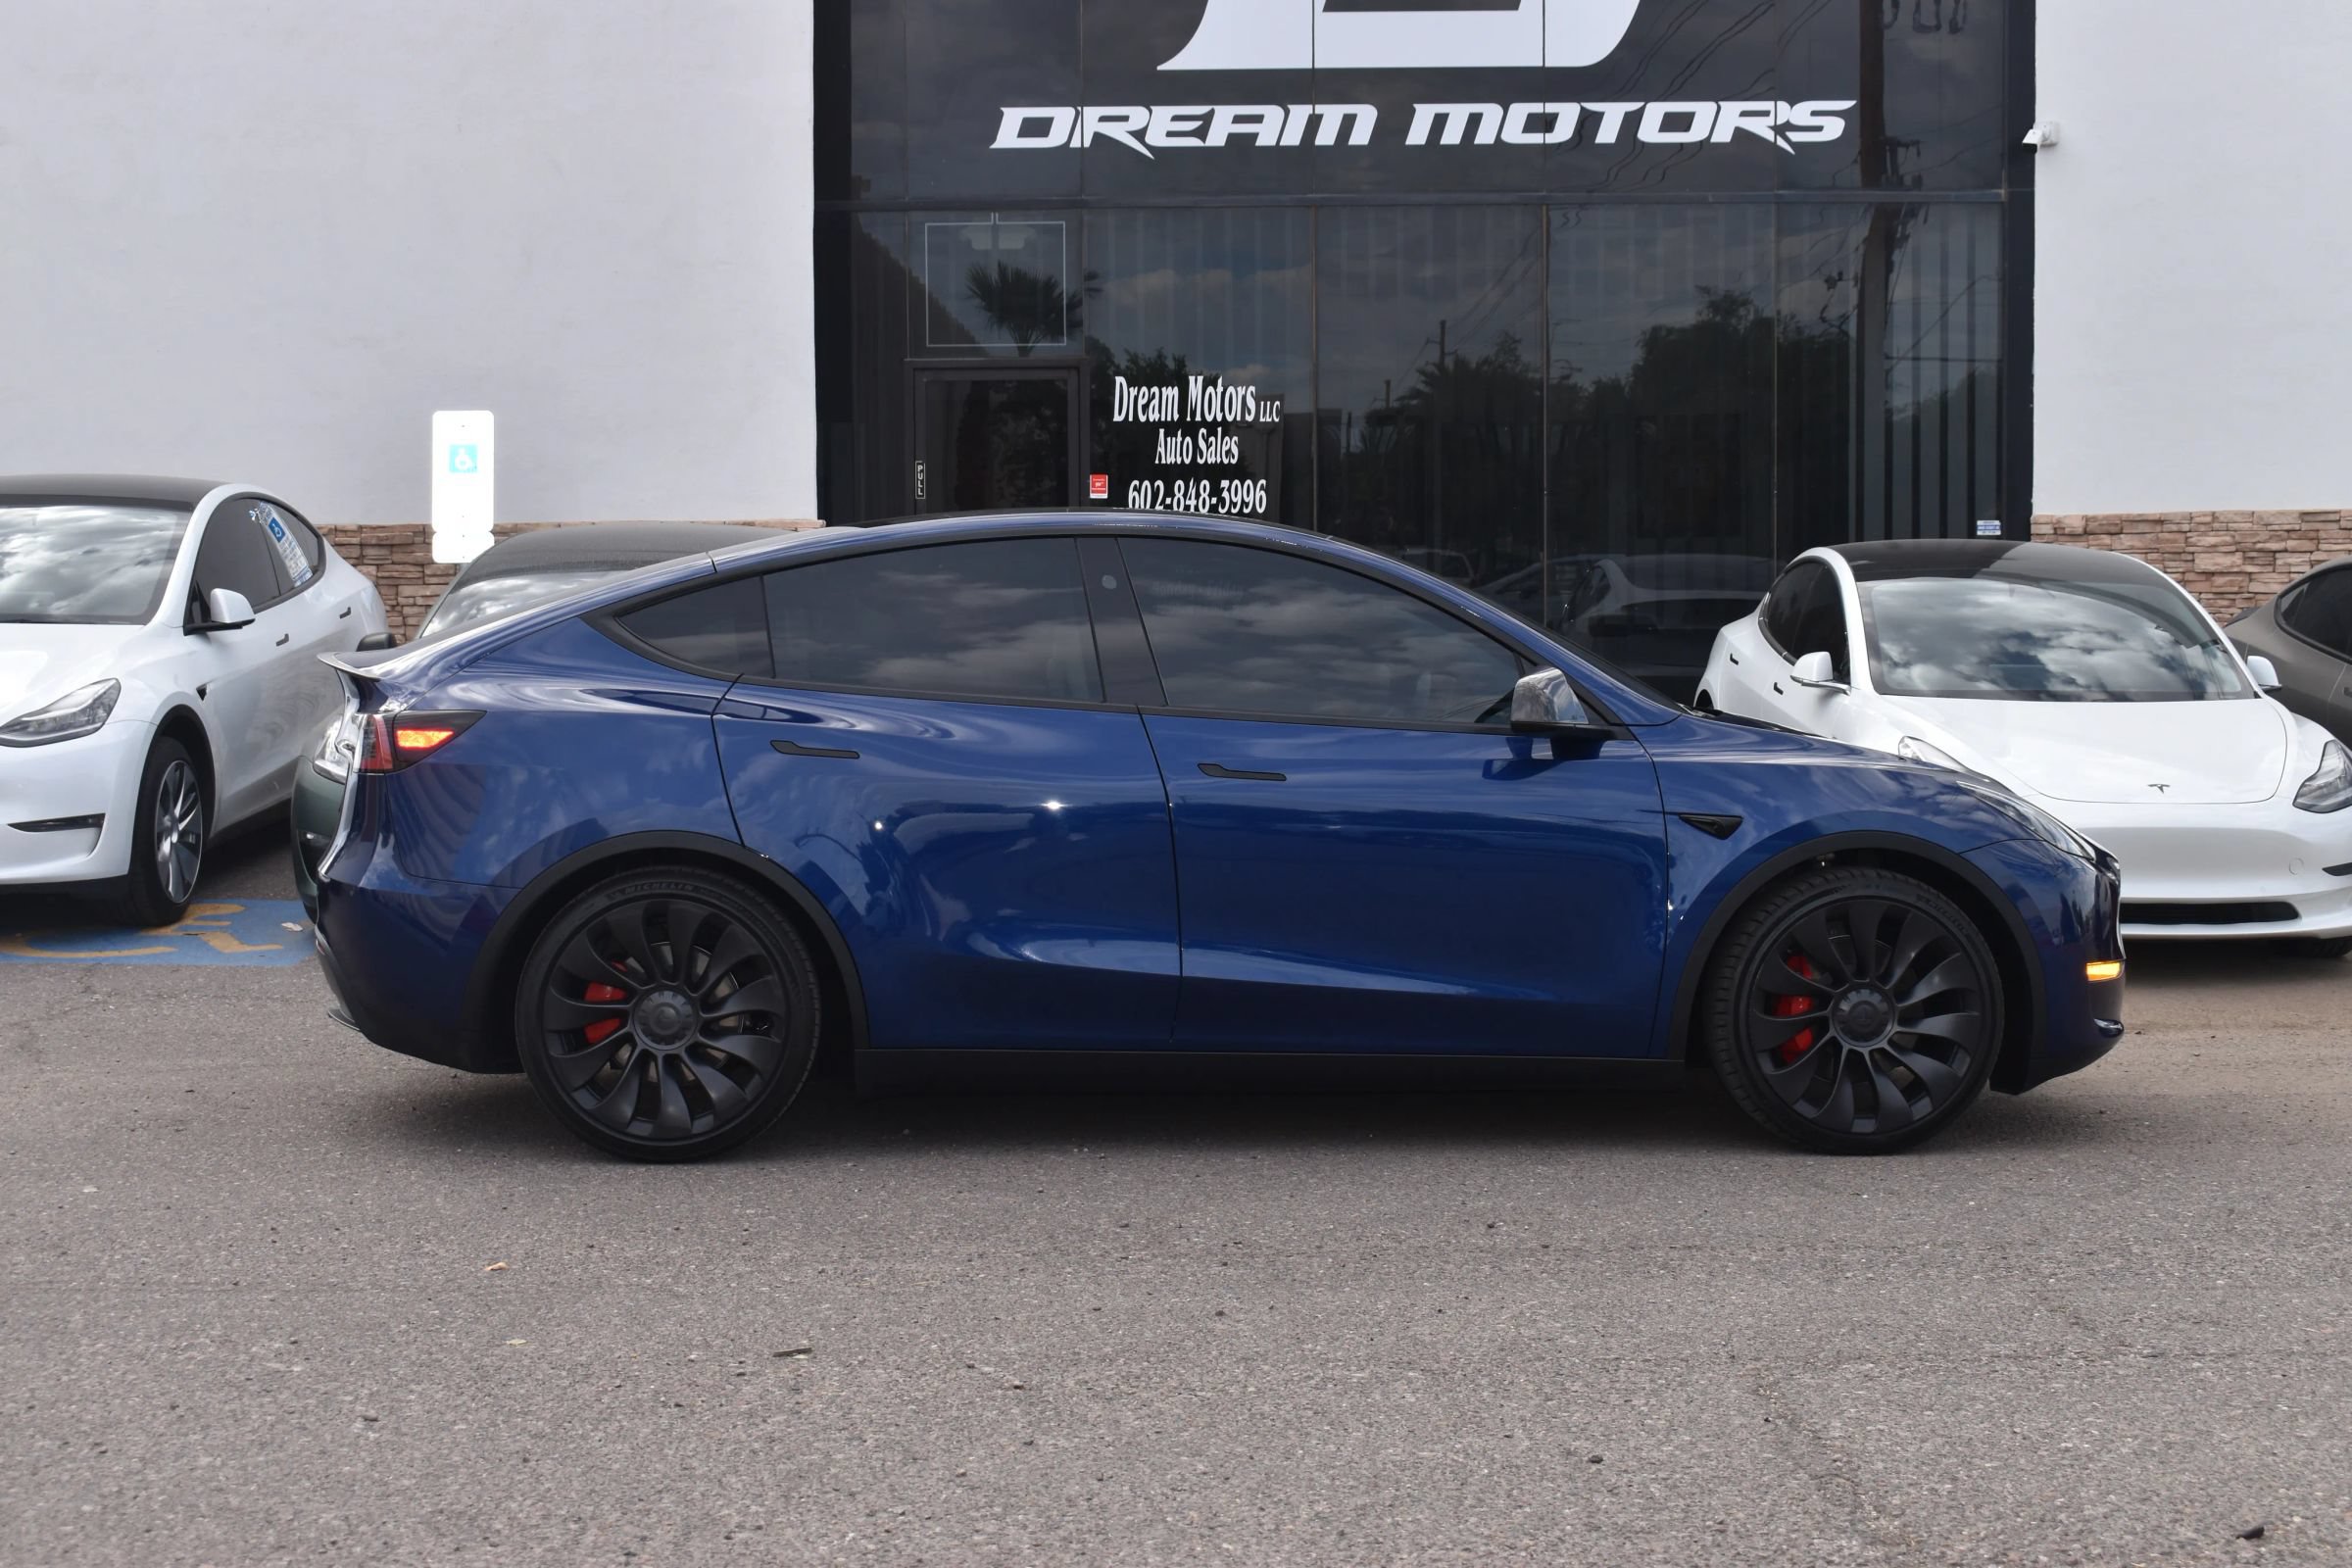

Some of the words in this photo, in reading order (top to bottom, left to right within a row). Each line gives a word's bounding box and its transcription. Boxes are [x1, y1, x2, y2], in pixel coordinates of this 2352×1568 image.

[989, 103, 1379, 160] DREAM
[1404, 100, 1858, 155] MOTORS
[1112, 375, 1179, 422] Dream
[1186, 375, 1256, 422] Motors
[1259, 401, 1281, 422] LLC
[1154, 428, 1193, 465] Auto
[1197, 426, 1239, 465] Sales
[1128, 477, 1267, 514] 602-848-3996
